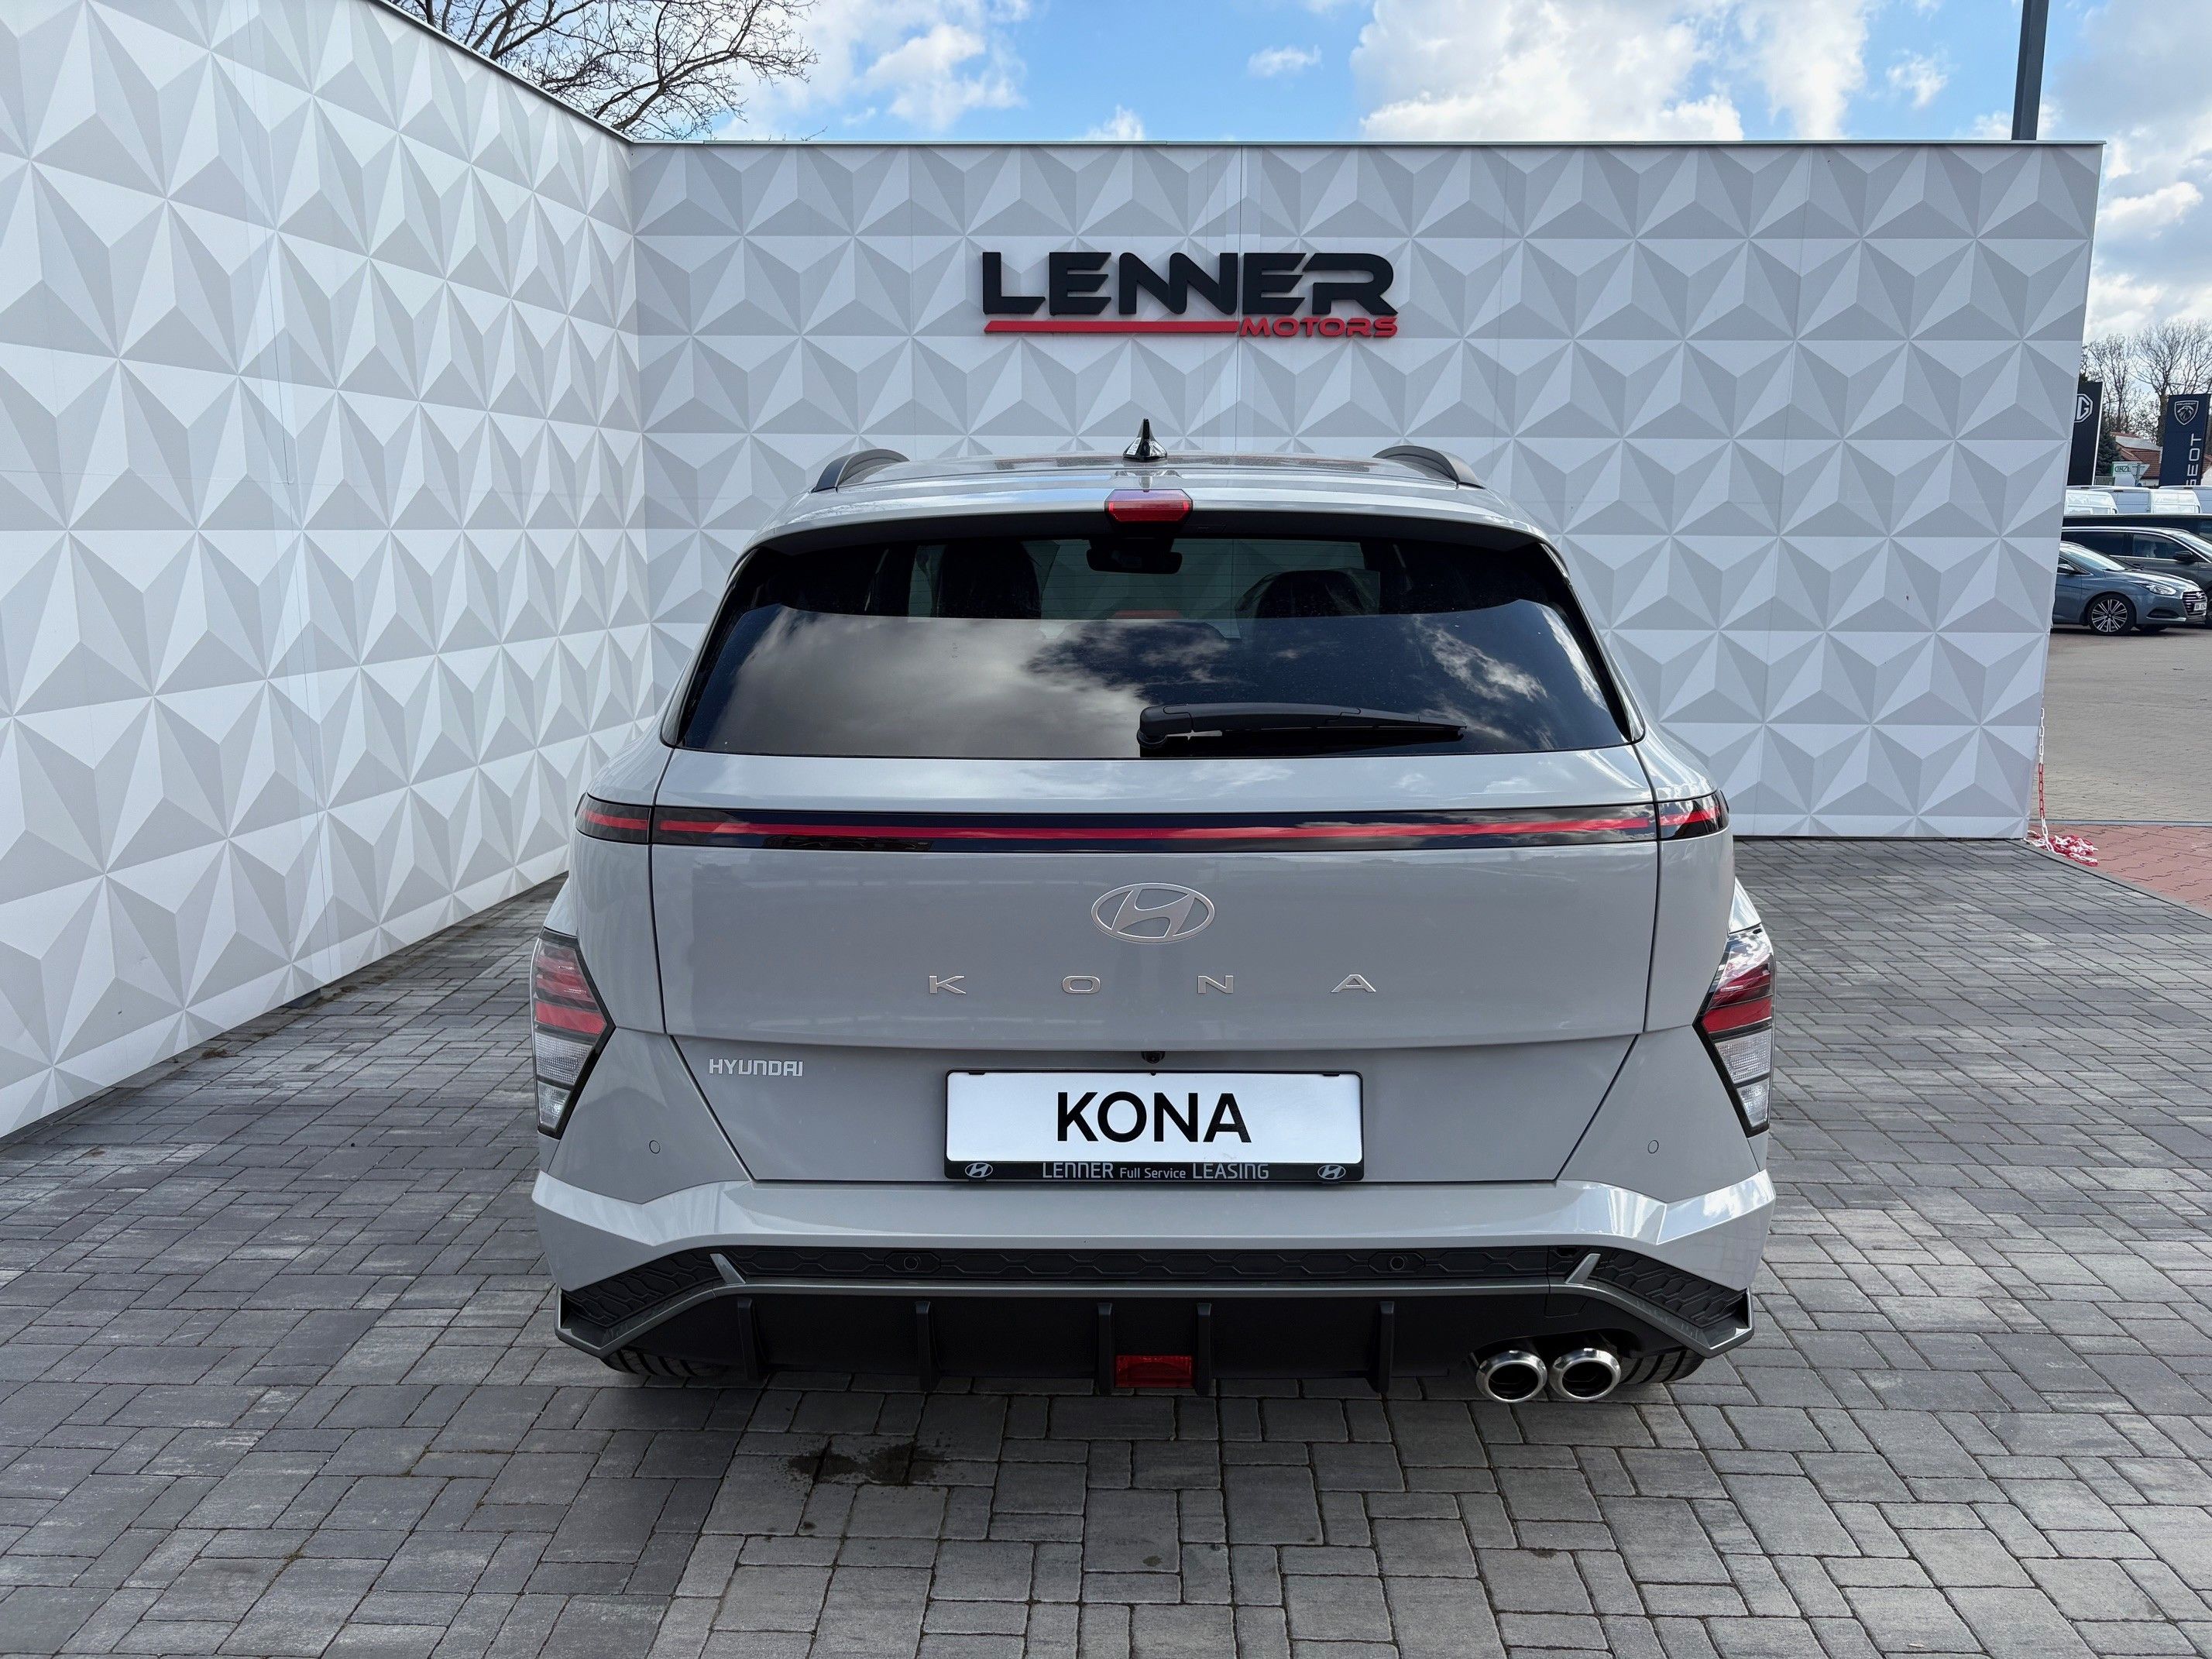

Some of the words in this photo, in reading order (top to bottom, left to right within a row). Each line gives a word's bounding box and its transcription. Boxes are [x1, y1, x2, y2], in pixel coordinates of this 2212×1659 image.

[982, 252, 1398, 315] LENNER
[1240, 317, 1398, 338] MOTORS
[929, 974, 1377, 994] KONA
[709, 1058, 803, 1077] HYUNDAI
[1057, 1091, 1252, 1142] KONA
[1042, 1162, 1114, 1178] LENNER
[1120, 1167, 1140, 1178] Full
[1144, 1167, 1187, 1179] Service
[1193, 1163, 1269, 1180] LEASING
